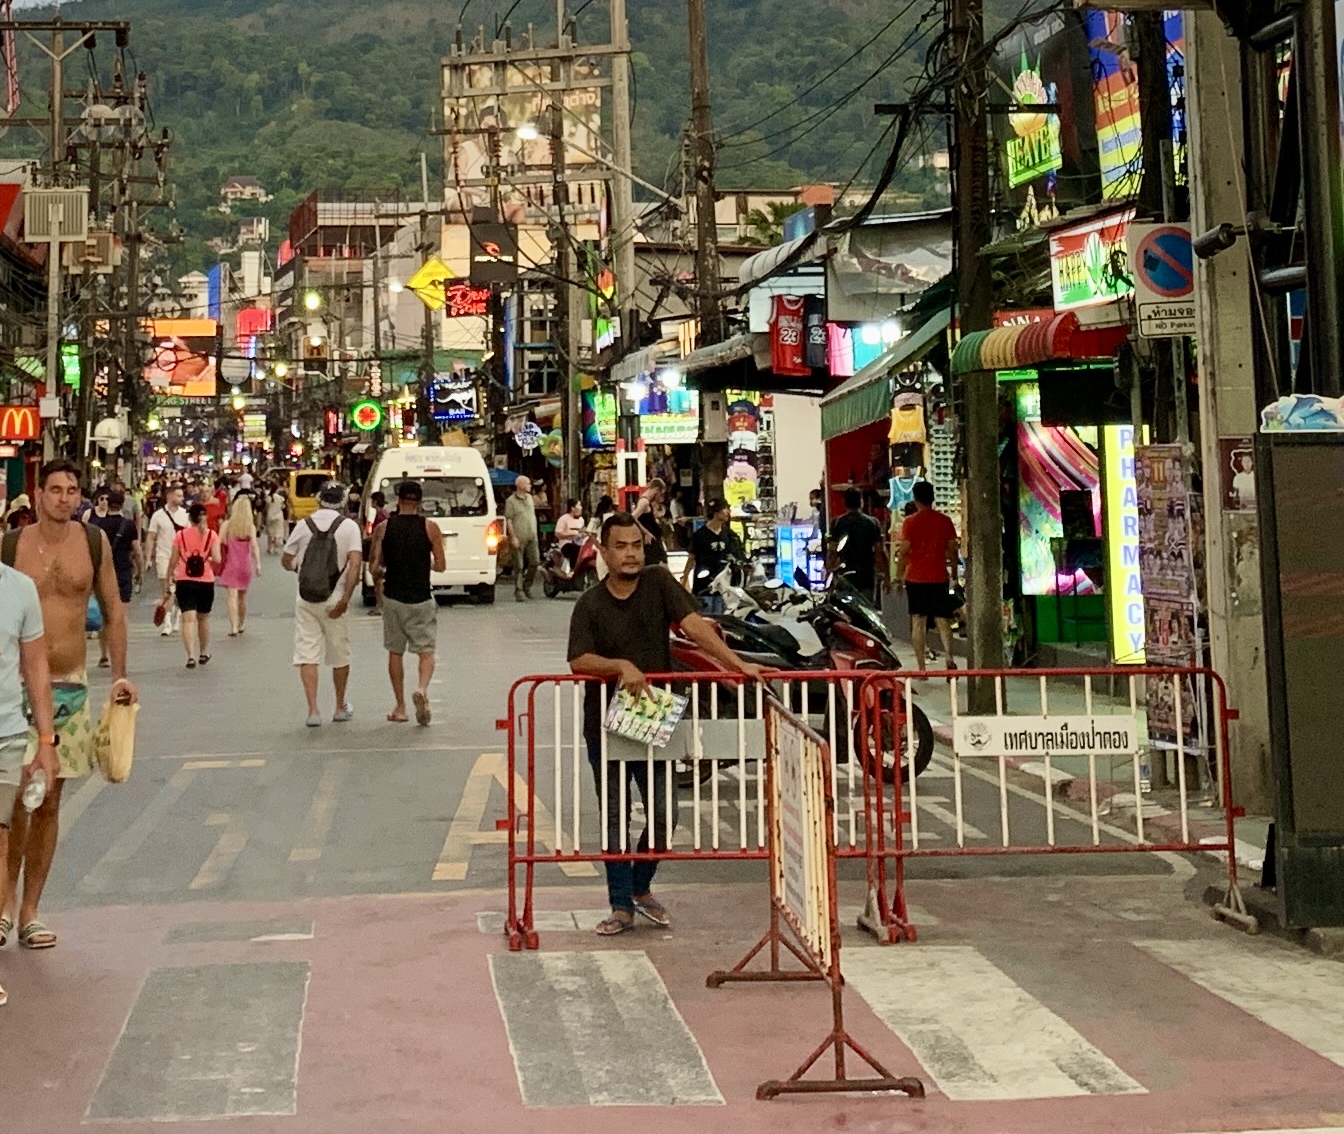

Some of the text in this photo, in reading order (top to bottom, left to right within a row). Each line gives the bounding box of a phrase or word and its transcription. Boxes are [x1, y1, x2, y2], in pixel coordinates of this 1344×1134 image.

[780, 327, 801, 346] 23
[1118, 428, 1144, 654] PHARMACY
[1003, 719, 1129, 751] เทศบาลเมืองป่าตอง
